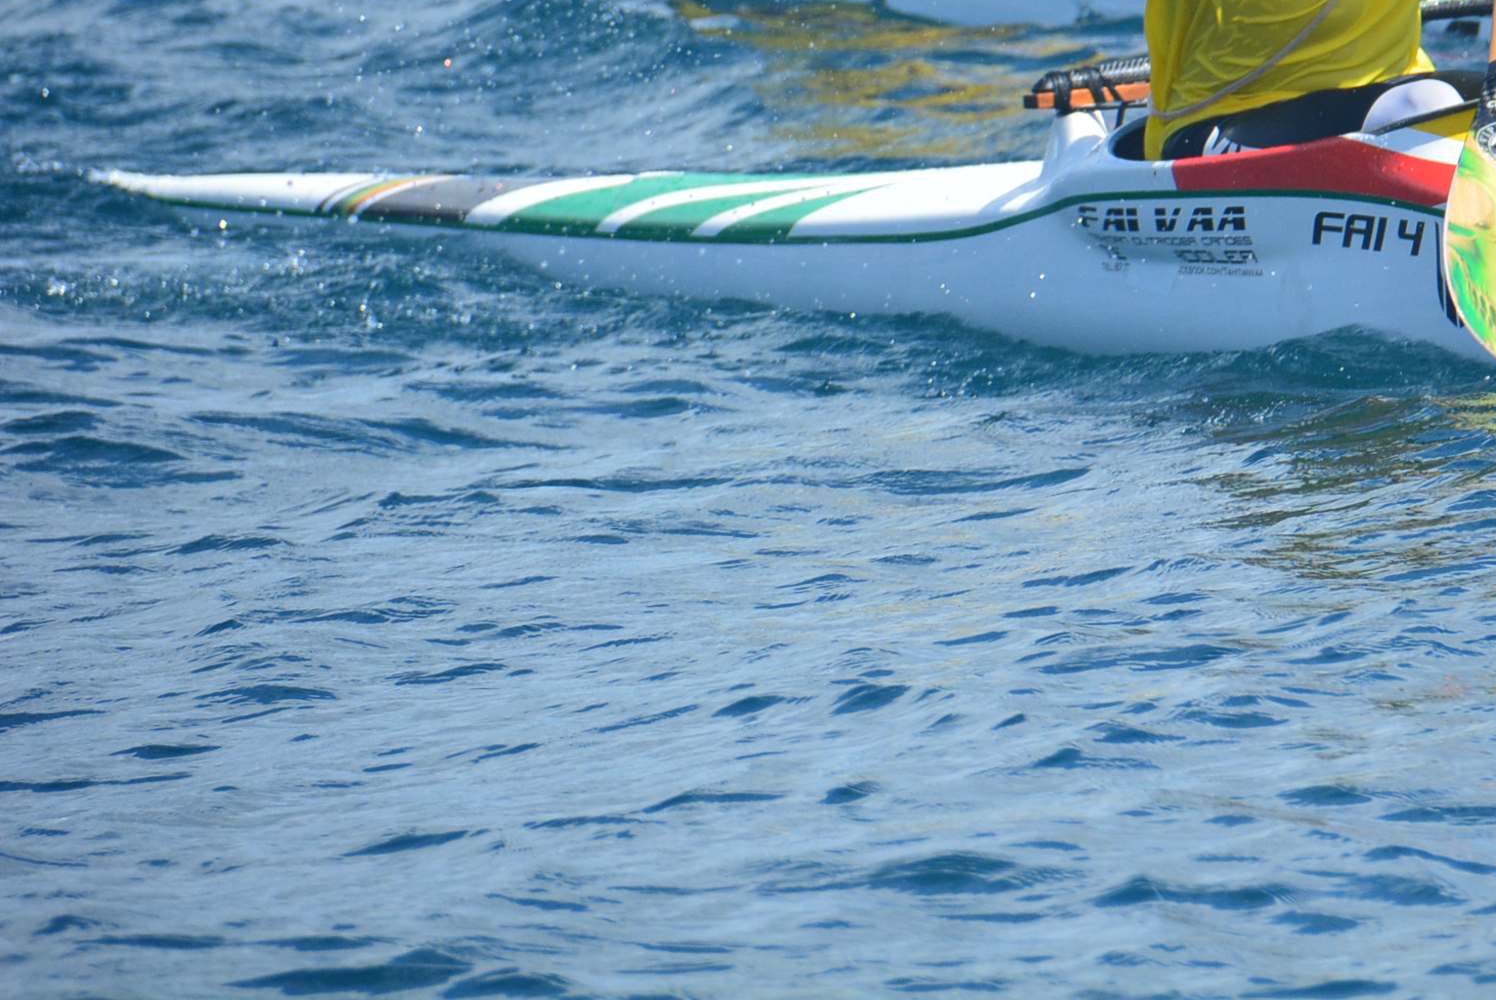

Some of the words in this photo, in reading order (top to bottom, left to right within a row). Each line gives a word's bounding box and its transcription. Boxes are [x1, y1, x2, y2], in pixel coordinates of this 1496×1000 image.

[1078, 206, 1140, 232] FAI
[1154, 206, 1247, 232] VAA
[1312, 211, 1388, 252] FAI
[1397, 218, 1426, 257] 4
